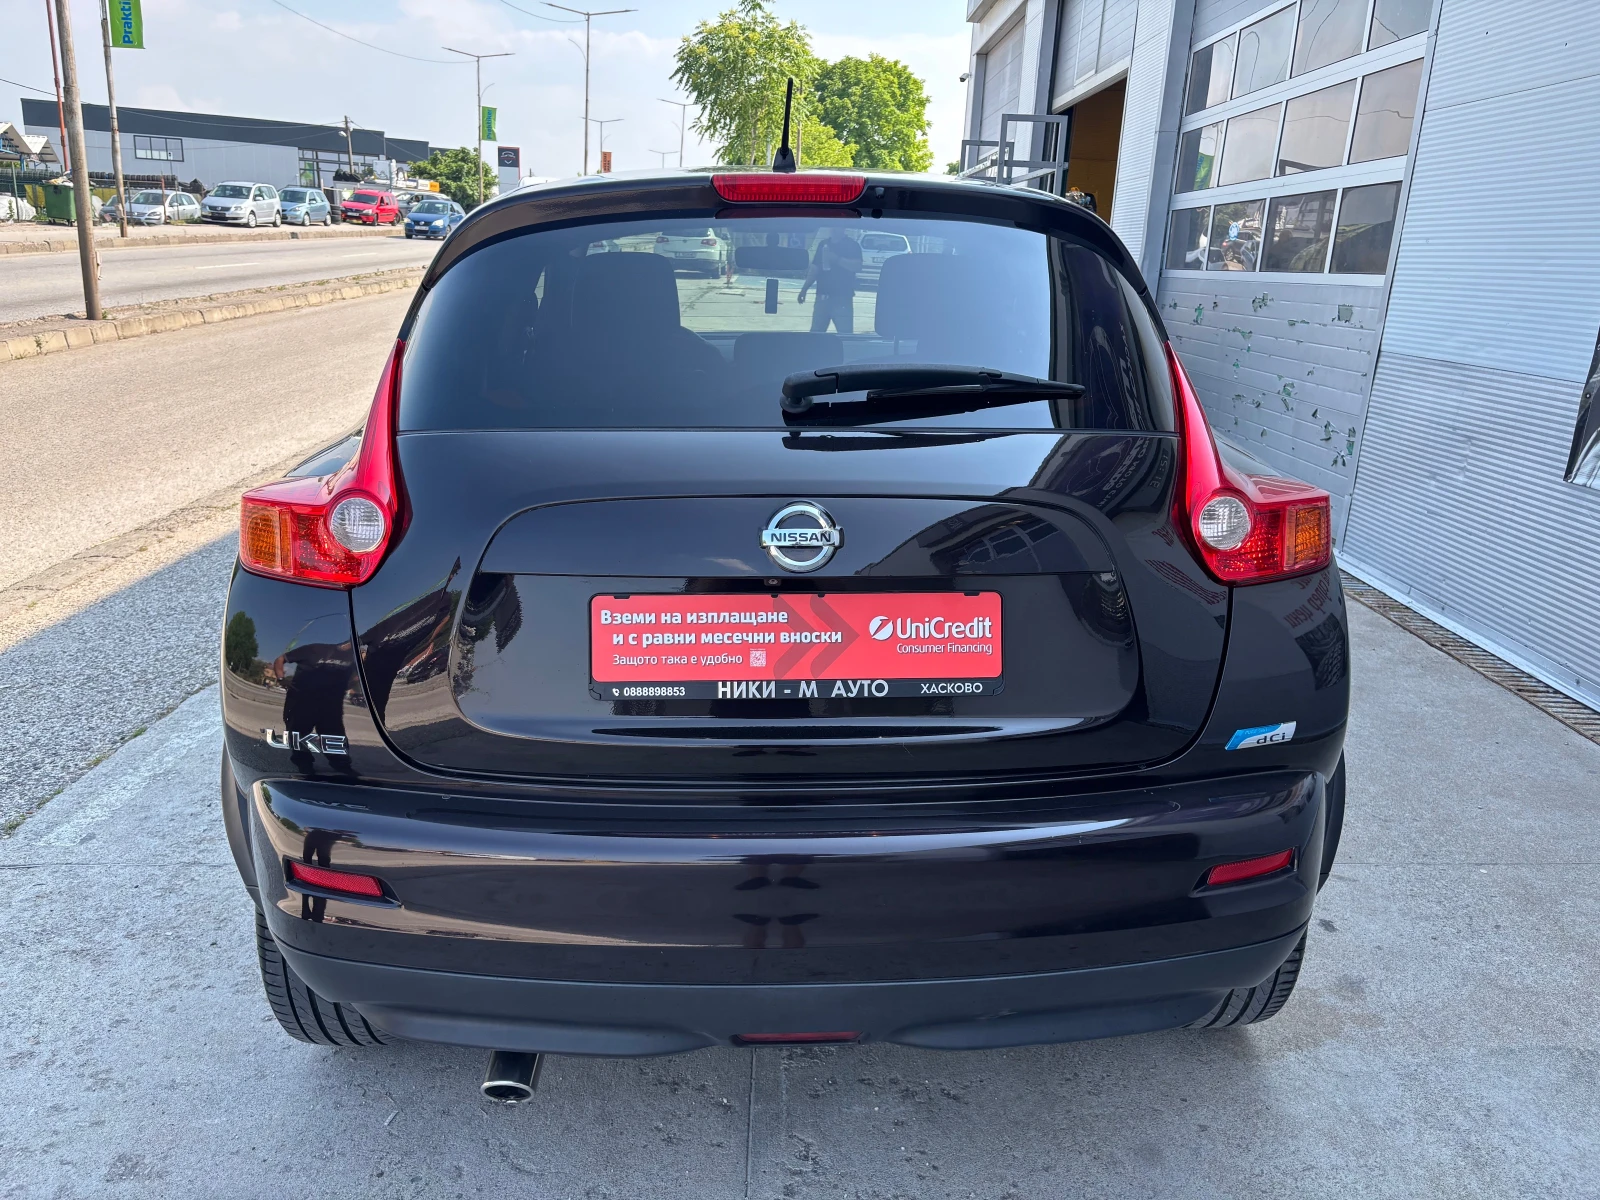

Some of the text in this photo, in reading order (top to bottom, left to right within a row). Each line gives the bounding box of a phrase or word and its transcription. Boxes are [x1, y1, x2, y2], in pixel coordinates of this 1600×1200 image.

[770, 532, 831, 543] NISSAN
[600, 609, 788, 625] Вземи на изплащане
[896, 616, 993, 639] UniCredit
[613, 631, 842, 648] и с равни месечни вноски
[897, 642, 993, 655] Consumer Financing
[613, 653, 743, 667] Защото така е удобно
[623, 687, 687, 697] 0888898853
[717, 680, 776, 698] НИКИ
[798, 680, 818, 698] М
[831, 679, 889, 698] АУТО
[920, 682, 983, 694] ХАСКОВО
[265, 728, 347, 755] UKE
